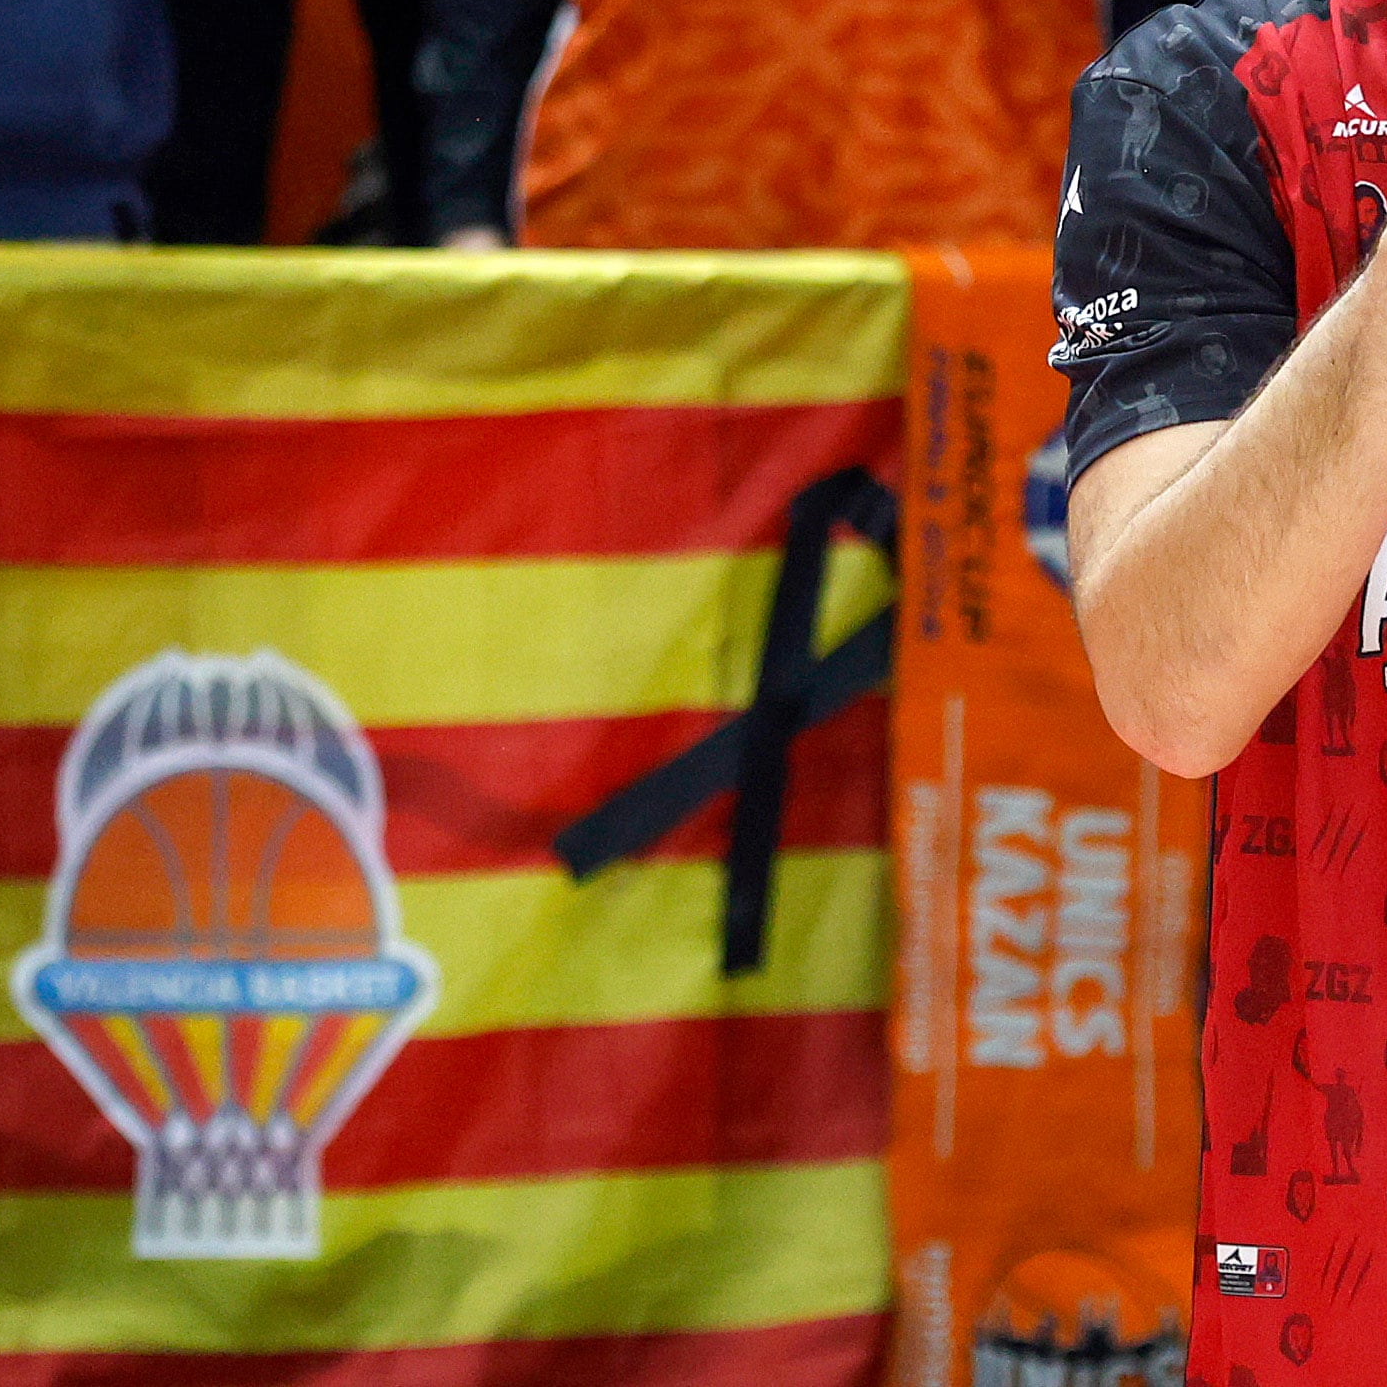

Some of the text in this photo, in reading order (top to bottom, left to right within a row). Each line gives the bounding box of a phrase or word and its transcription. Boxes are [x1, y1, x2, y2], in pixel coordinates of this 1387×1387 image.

[969, 784, 1056, 1071] KAZAN
[1054, 809, 1133, 1055] UNICS
[1304, 961, 1372, 1003] ZGZ
